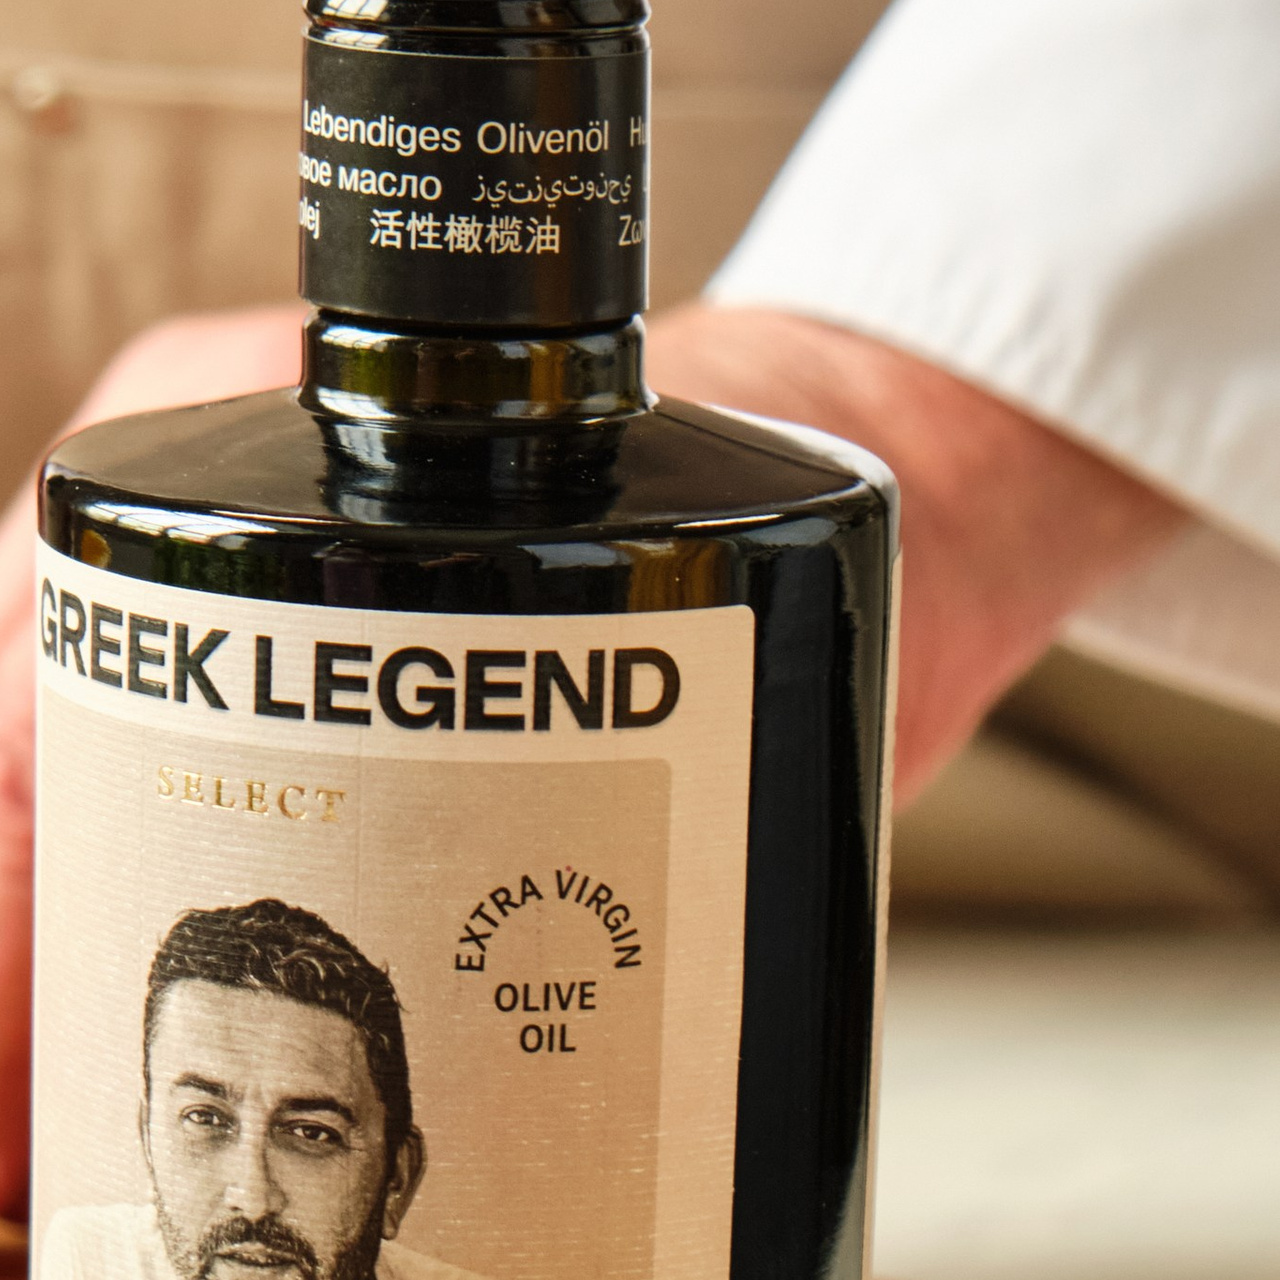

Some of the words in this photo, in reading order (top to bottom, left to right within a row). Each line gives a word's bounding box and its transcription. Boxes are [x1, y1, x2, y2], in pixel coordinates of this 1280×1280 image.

[303, 99, 462, 157] Lebendiges
[477, 120, 610, 154] Olivenöl
[337, 165, 443, 202] масло
[369, 208, 562, 255] 活性橄榄油
[40, 576, 232, 712] GREEK
[253, 635, 681, 732] LEGEND
[157, 765, 348, 822] SELECT
[454, 874, 544, 972] EXTRA
[555, 869, 642, 969] VIRGIN
[494, 981, 597, 1013] OLIVE
[519, 1023, 577, 1053] OIL
